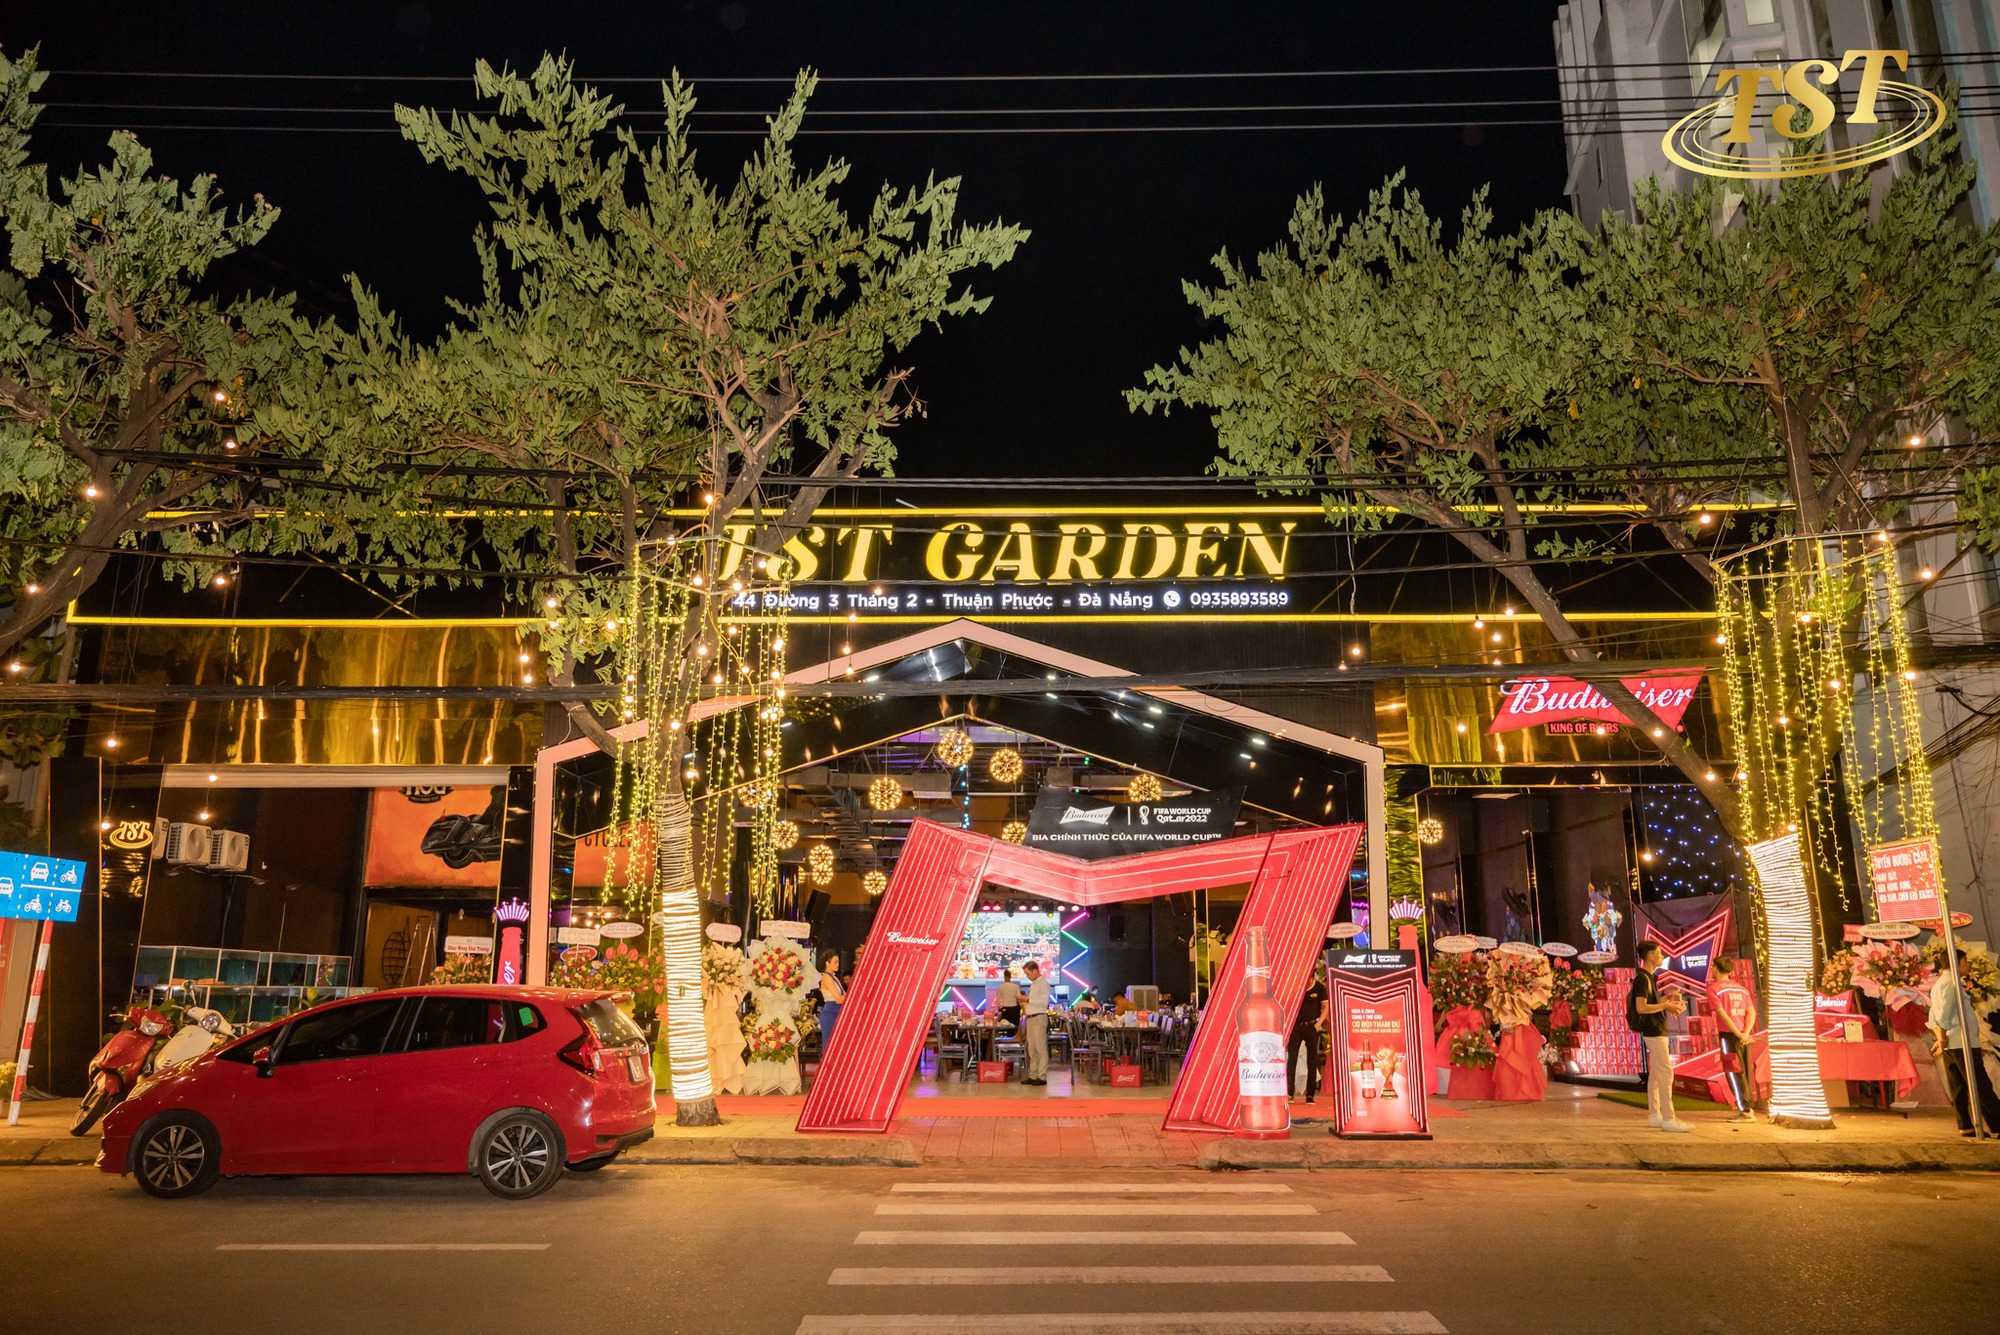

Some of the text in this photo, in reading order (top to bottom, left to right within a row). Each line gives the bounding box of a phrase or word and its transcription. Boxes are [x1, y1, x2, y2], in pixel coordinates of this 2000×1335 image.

[926, 522, 1297, 582] GARDEN
[733, 593, 757, 608] 44
[764, 592, 820, 610] Đường
[829, 593, 839, 608] 3
[847, 592, 899, 610] Tháng
[907, 593, 918, 608] 2
[943, 592, 993, 611] Thuận
[1003, 592, 1053, 608] Phước
[1079, 592, 1102, 607] Đà
[1110, 590, 1153, 609] Nẵng
[1190, 591, 1289, 606] 0935893589
[1550, 723, 1573, 733] KING
[1575, 723, 1588, 733] OF
[1153, 807, 1212, 815] FIFA WORLD CUP
[118, 820, 150, 841] TST
[1032, 833, 1048, 841] BIA
[1050, 832, 1081, 841] CHÍNH
[1082, 831, 1109, 841] THỨC
[1111, 831, 1133, 841] CỦA
[886, 931, 939, 945] Budweiser
[1815, 995, 1848, 1008] Budweiser
[1241, 1067, 1285, 1080] Budweiser
